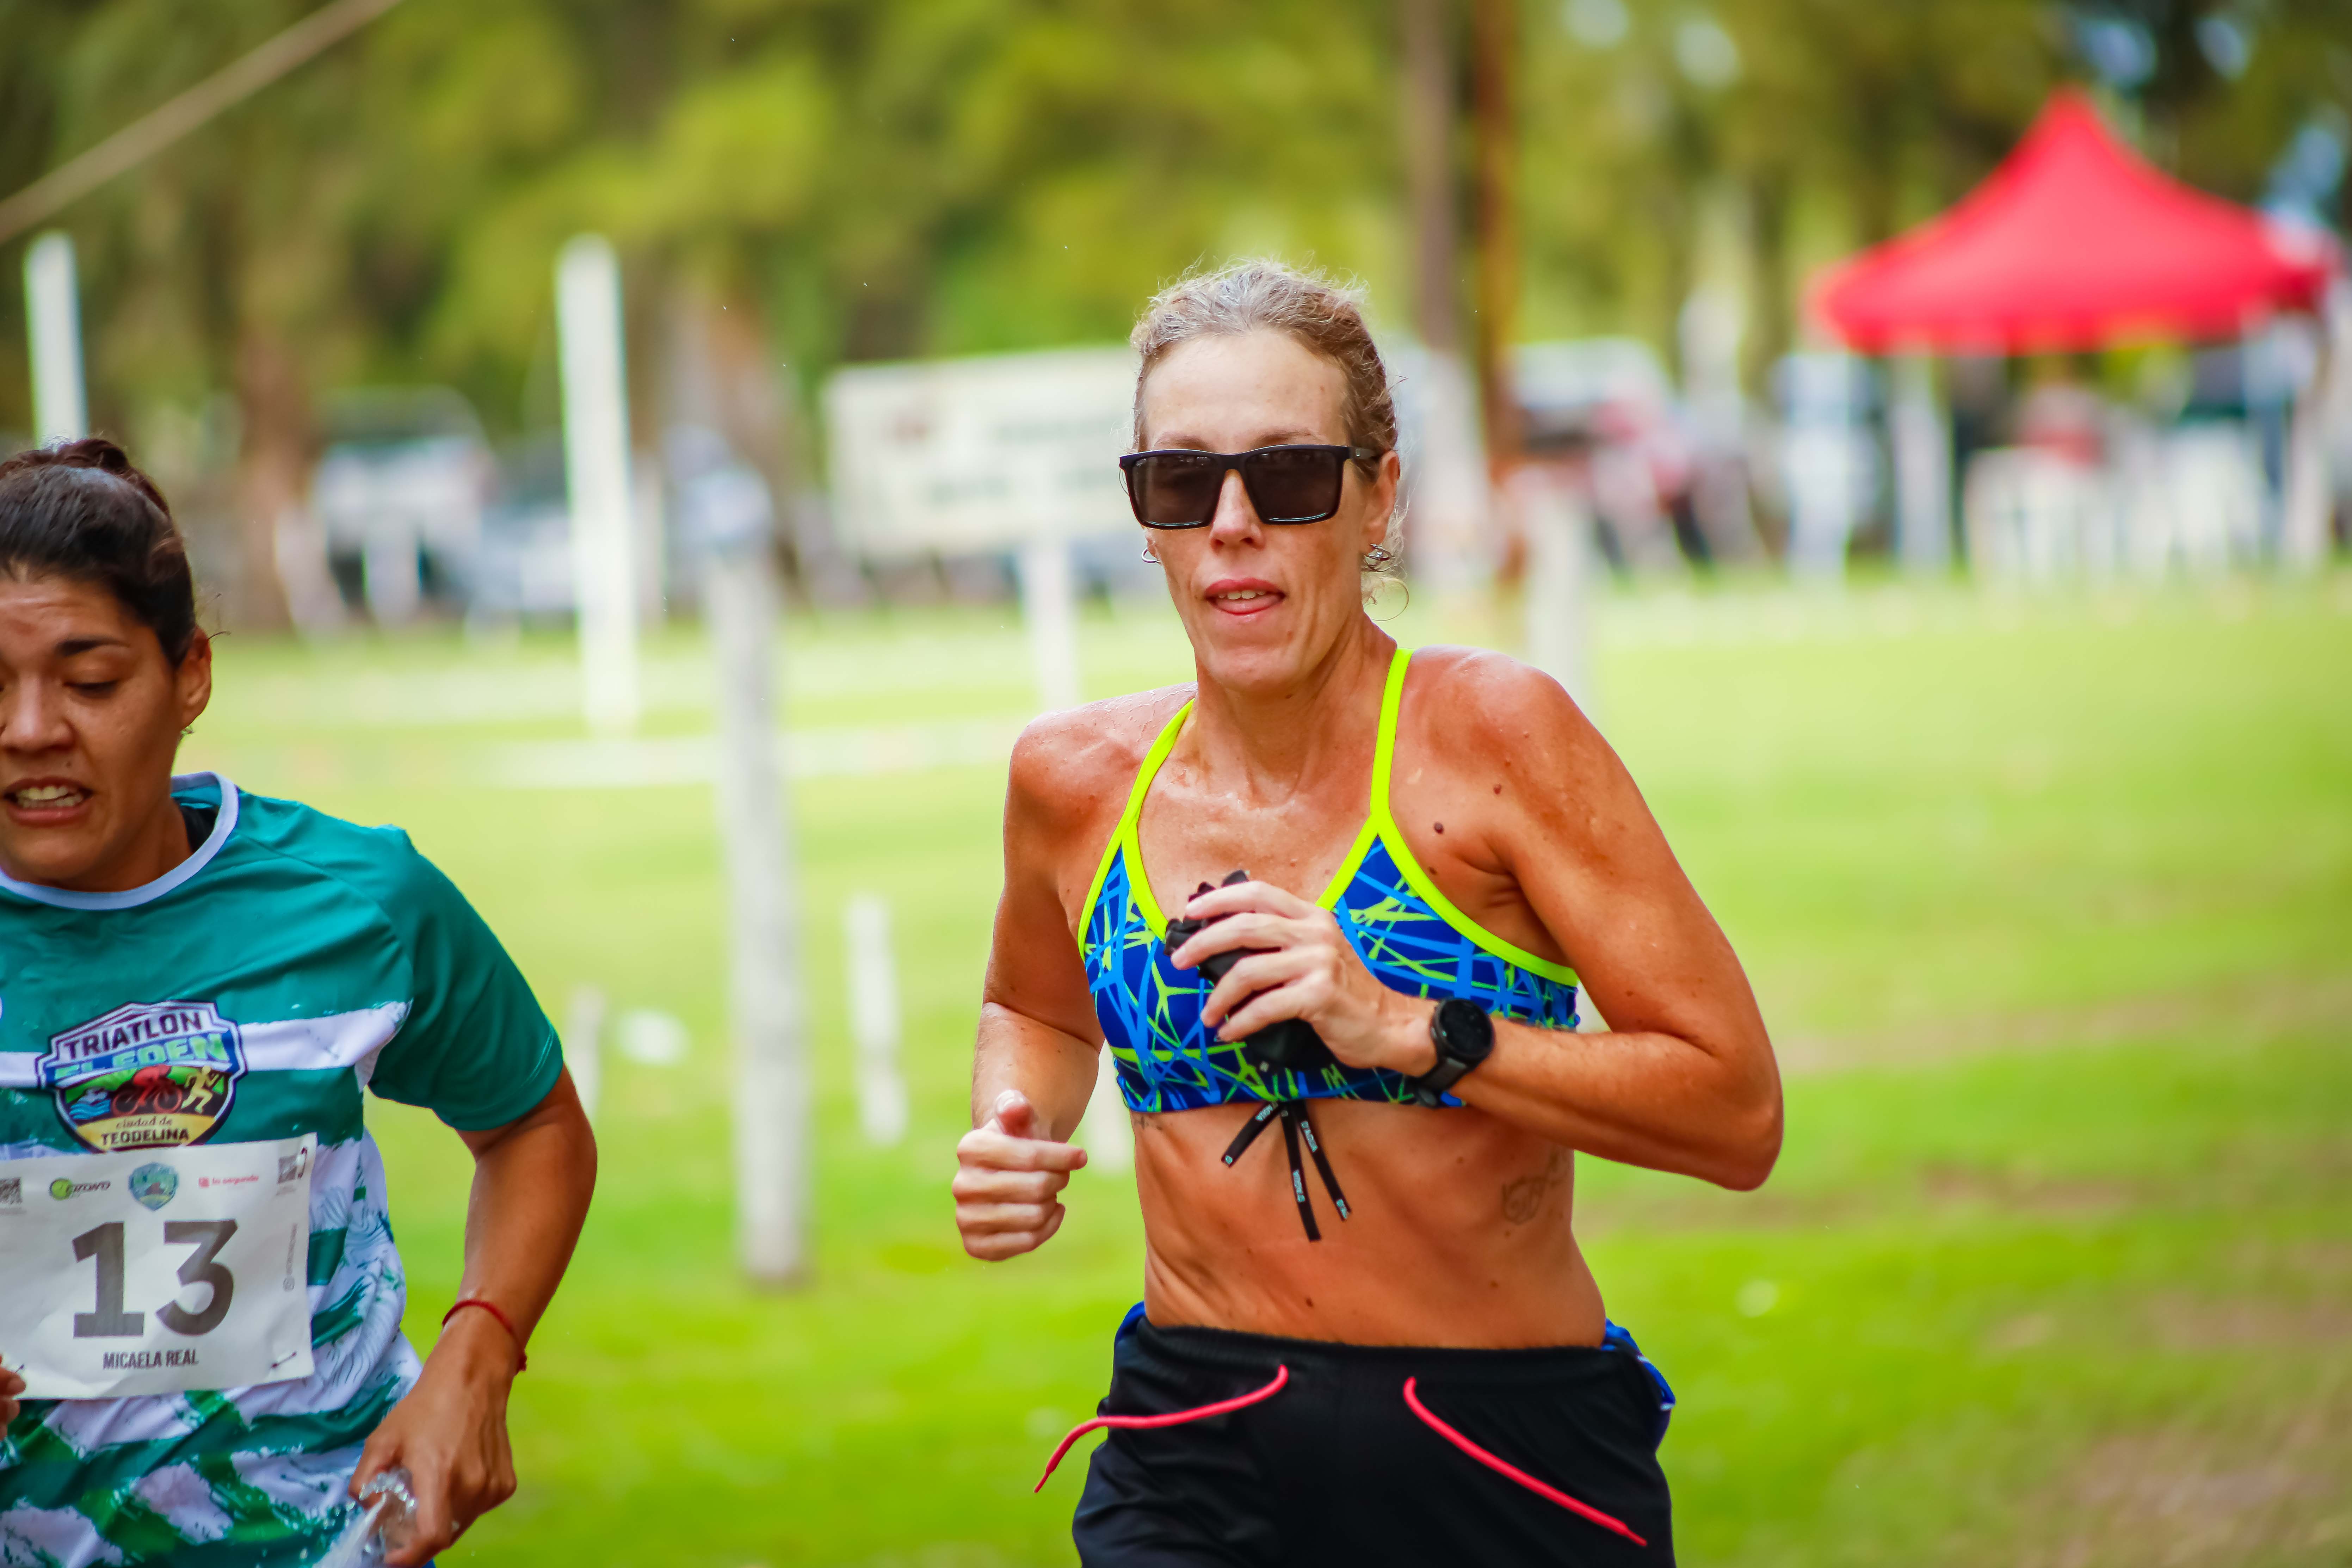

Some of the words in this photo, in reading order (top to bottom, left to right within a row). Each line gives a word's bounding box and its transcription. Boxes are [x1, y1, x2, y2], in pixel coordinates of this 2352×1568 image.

[64, 1010, 202, 1059] TRIATLON
[55, 1059, 105, 1080] EL
[113, 1033, 230, 1067] EDEN
[101, 1128, 189, 1146] TEODELINA
[159, 1116, 172, 1125] de
[72, 1218, 238, 1339] 13
[103, 1351, 162, 1370] MICAELA
[166, 1349, 199, 1366] REAL
